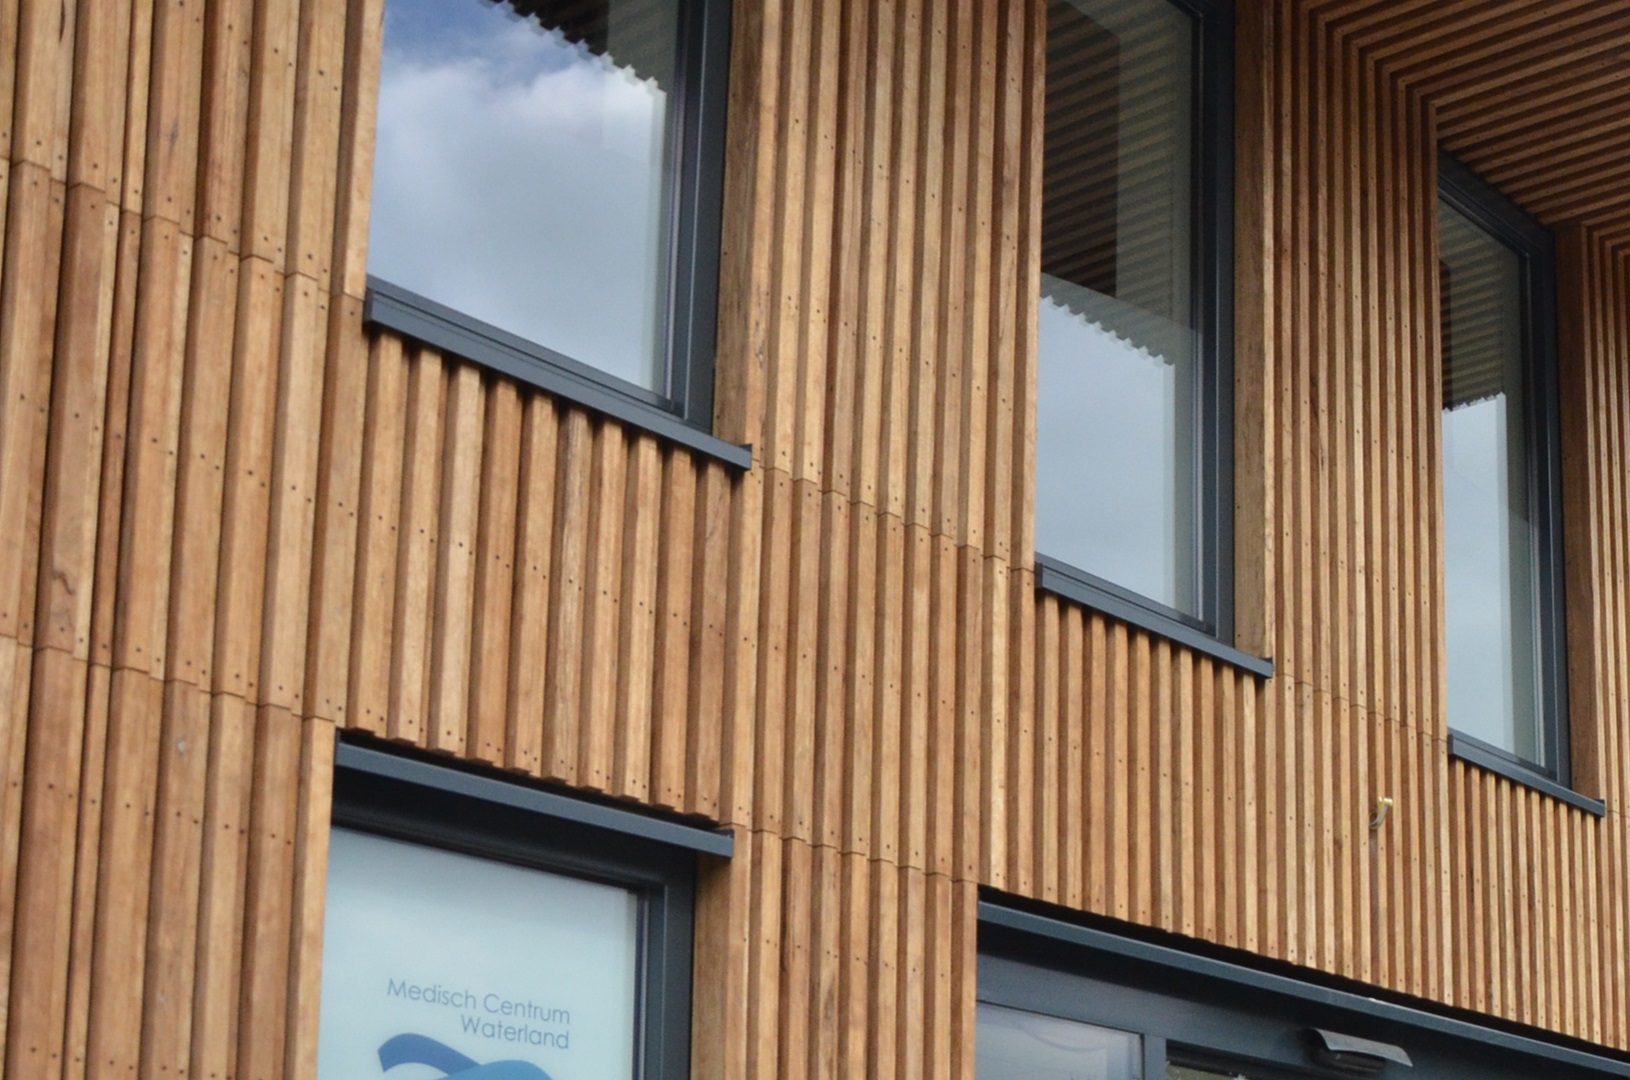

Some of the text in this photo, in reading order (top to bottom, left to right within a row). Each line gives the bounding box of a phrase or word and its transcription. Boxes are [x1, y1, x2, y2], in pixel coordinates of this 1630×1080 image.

[387, 978, 571, 1024] Medisch Centrum
[461, 1014, 569, 1049] Waterland
